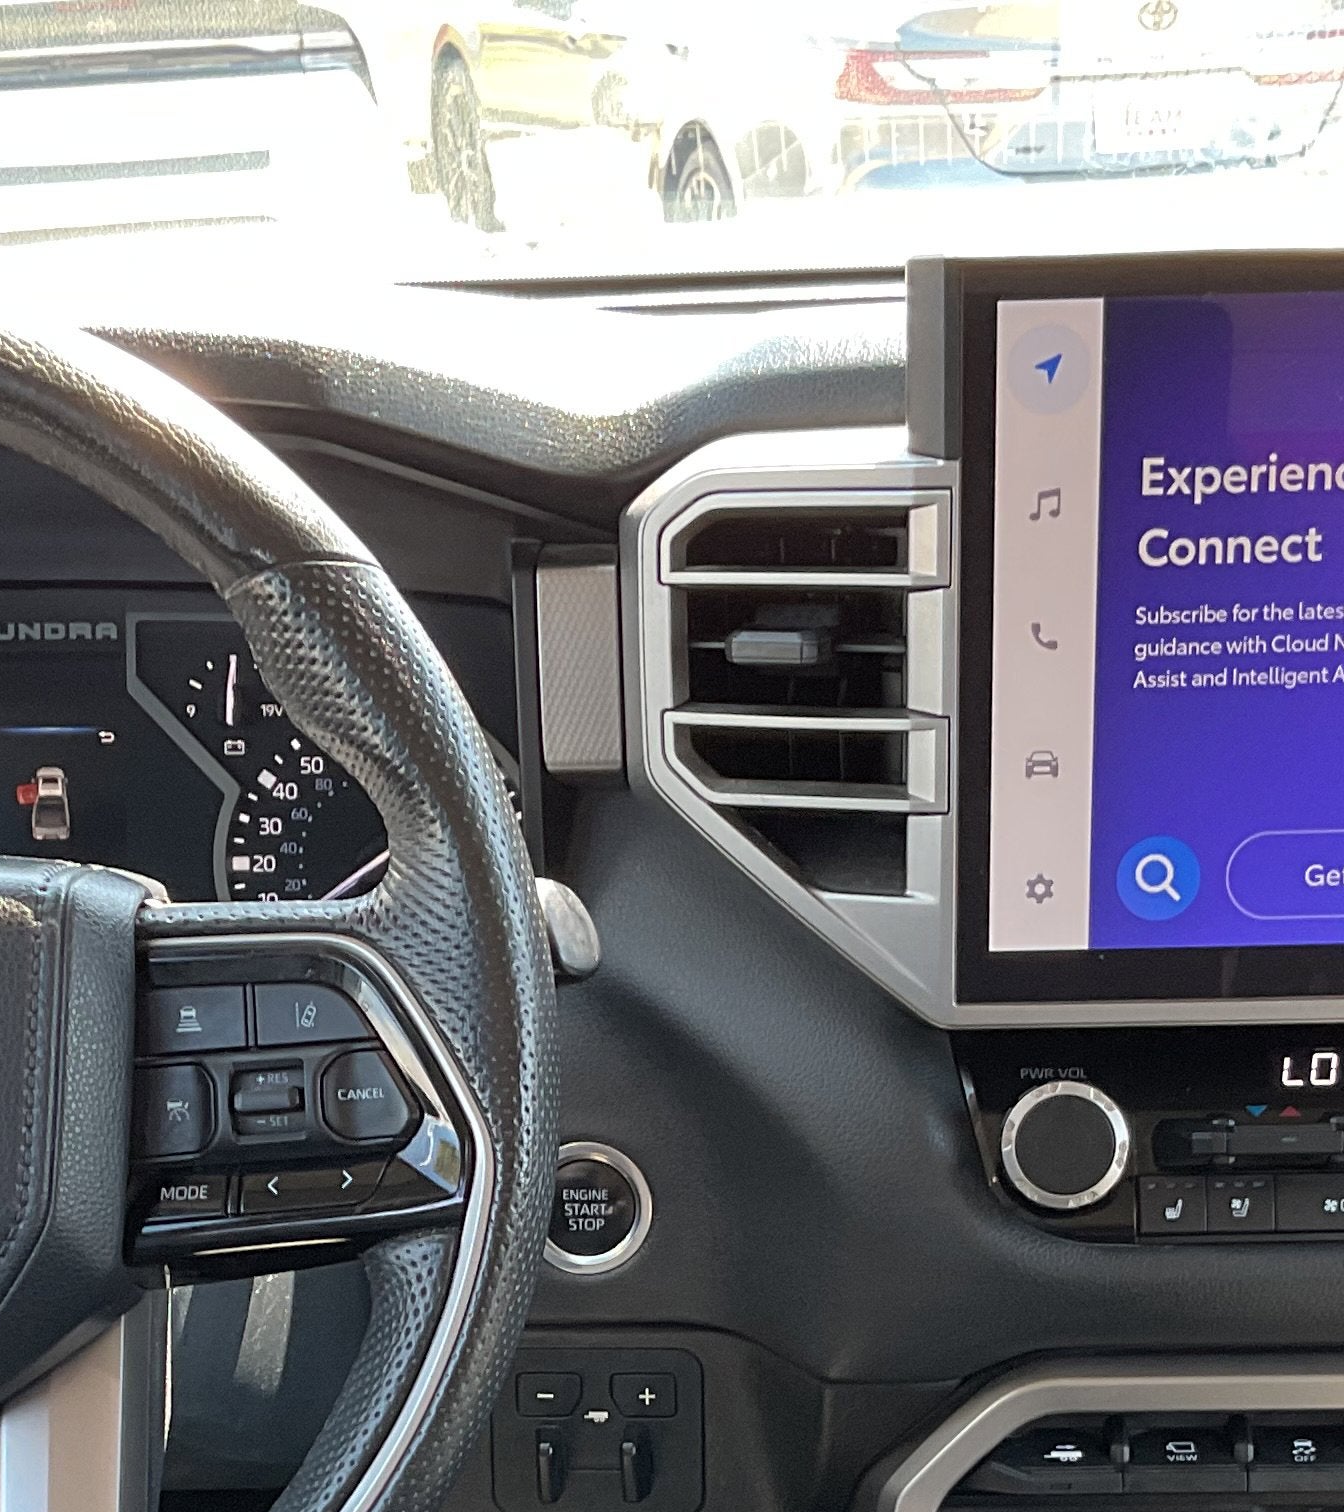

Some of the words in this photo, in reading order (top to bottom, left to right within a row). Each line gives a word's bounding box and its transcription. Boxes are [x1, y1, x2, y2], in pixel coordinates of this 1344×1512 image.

[1138, 527, 1323, 567] Connect
[1135, 604, 1227, 625] Subscribe
[1232, 604, 1259, 623] for
[1262, 603, 1294, 622] the
[1134, 638, 1222, 662] guidance
[1226, 636, 1267, 655] with
[1271, 634, 1329, 654] Cloud
[1133, 669, 1187, 689] Assist
[1191, 667, 1228, 688] and
[1233, 665, 1328, 690] Intelligent
[186, 704, 196, 718] 9
[260, 704, 284, 718] 19V
[300, 756, 325, 774] 50
[272, 781, 298, 800] 40
[290, 807, 308, 821] 60
[259, 817, 282, 835] 30
[279, 842, 297, 854] 40
[252, 855, 276, 873] 20
[284, 879, 301, 891] 20
[1020, 1066, 1056, 1080] PWR
[1058, 1066, 1088, 1080] VOL
[338, 1087, 385, 1101] CANCEL
[160, 1185, 208, 1201] MODE
[562, 1188, 609, 1201] ENGINE
[564, 1203, 607, 1217] START
[568, 1218, 605, 1231] STOP
[1166, 1453, 1198, 1462] VIEW
[1293, 1454, 1317, 1463] OFF
